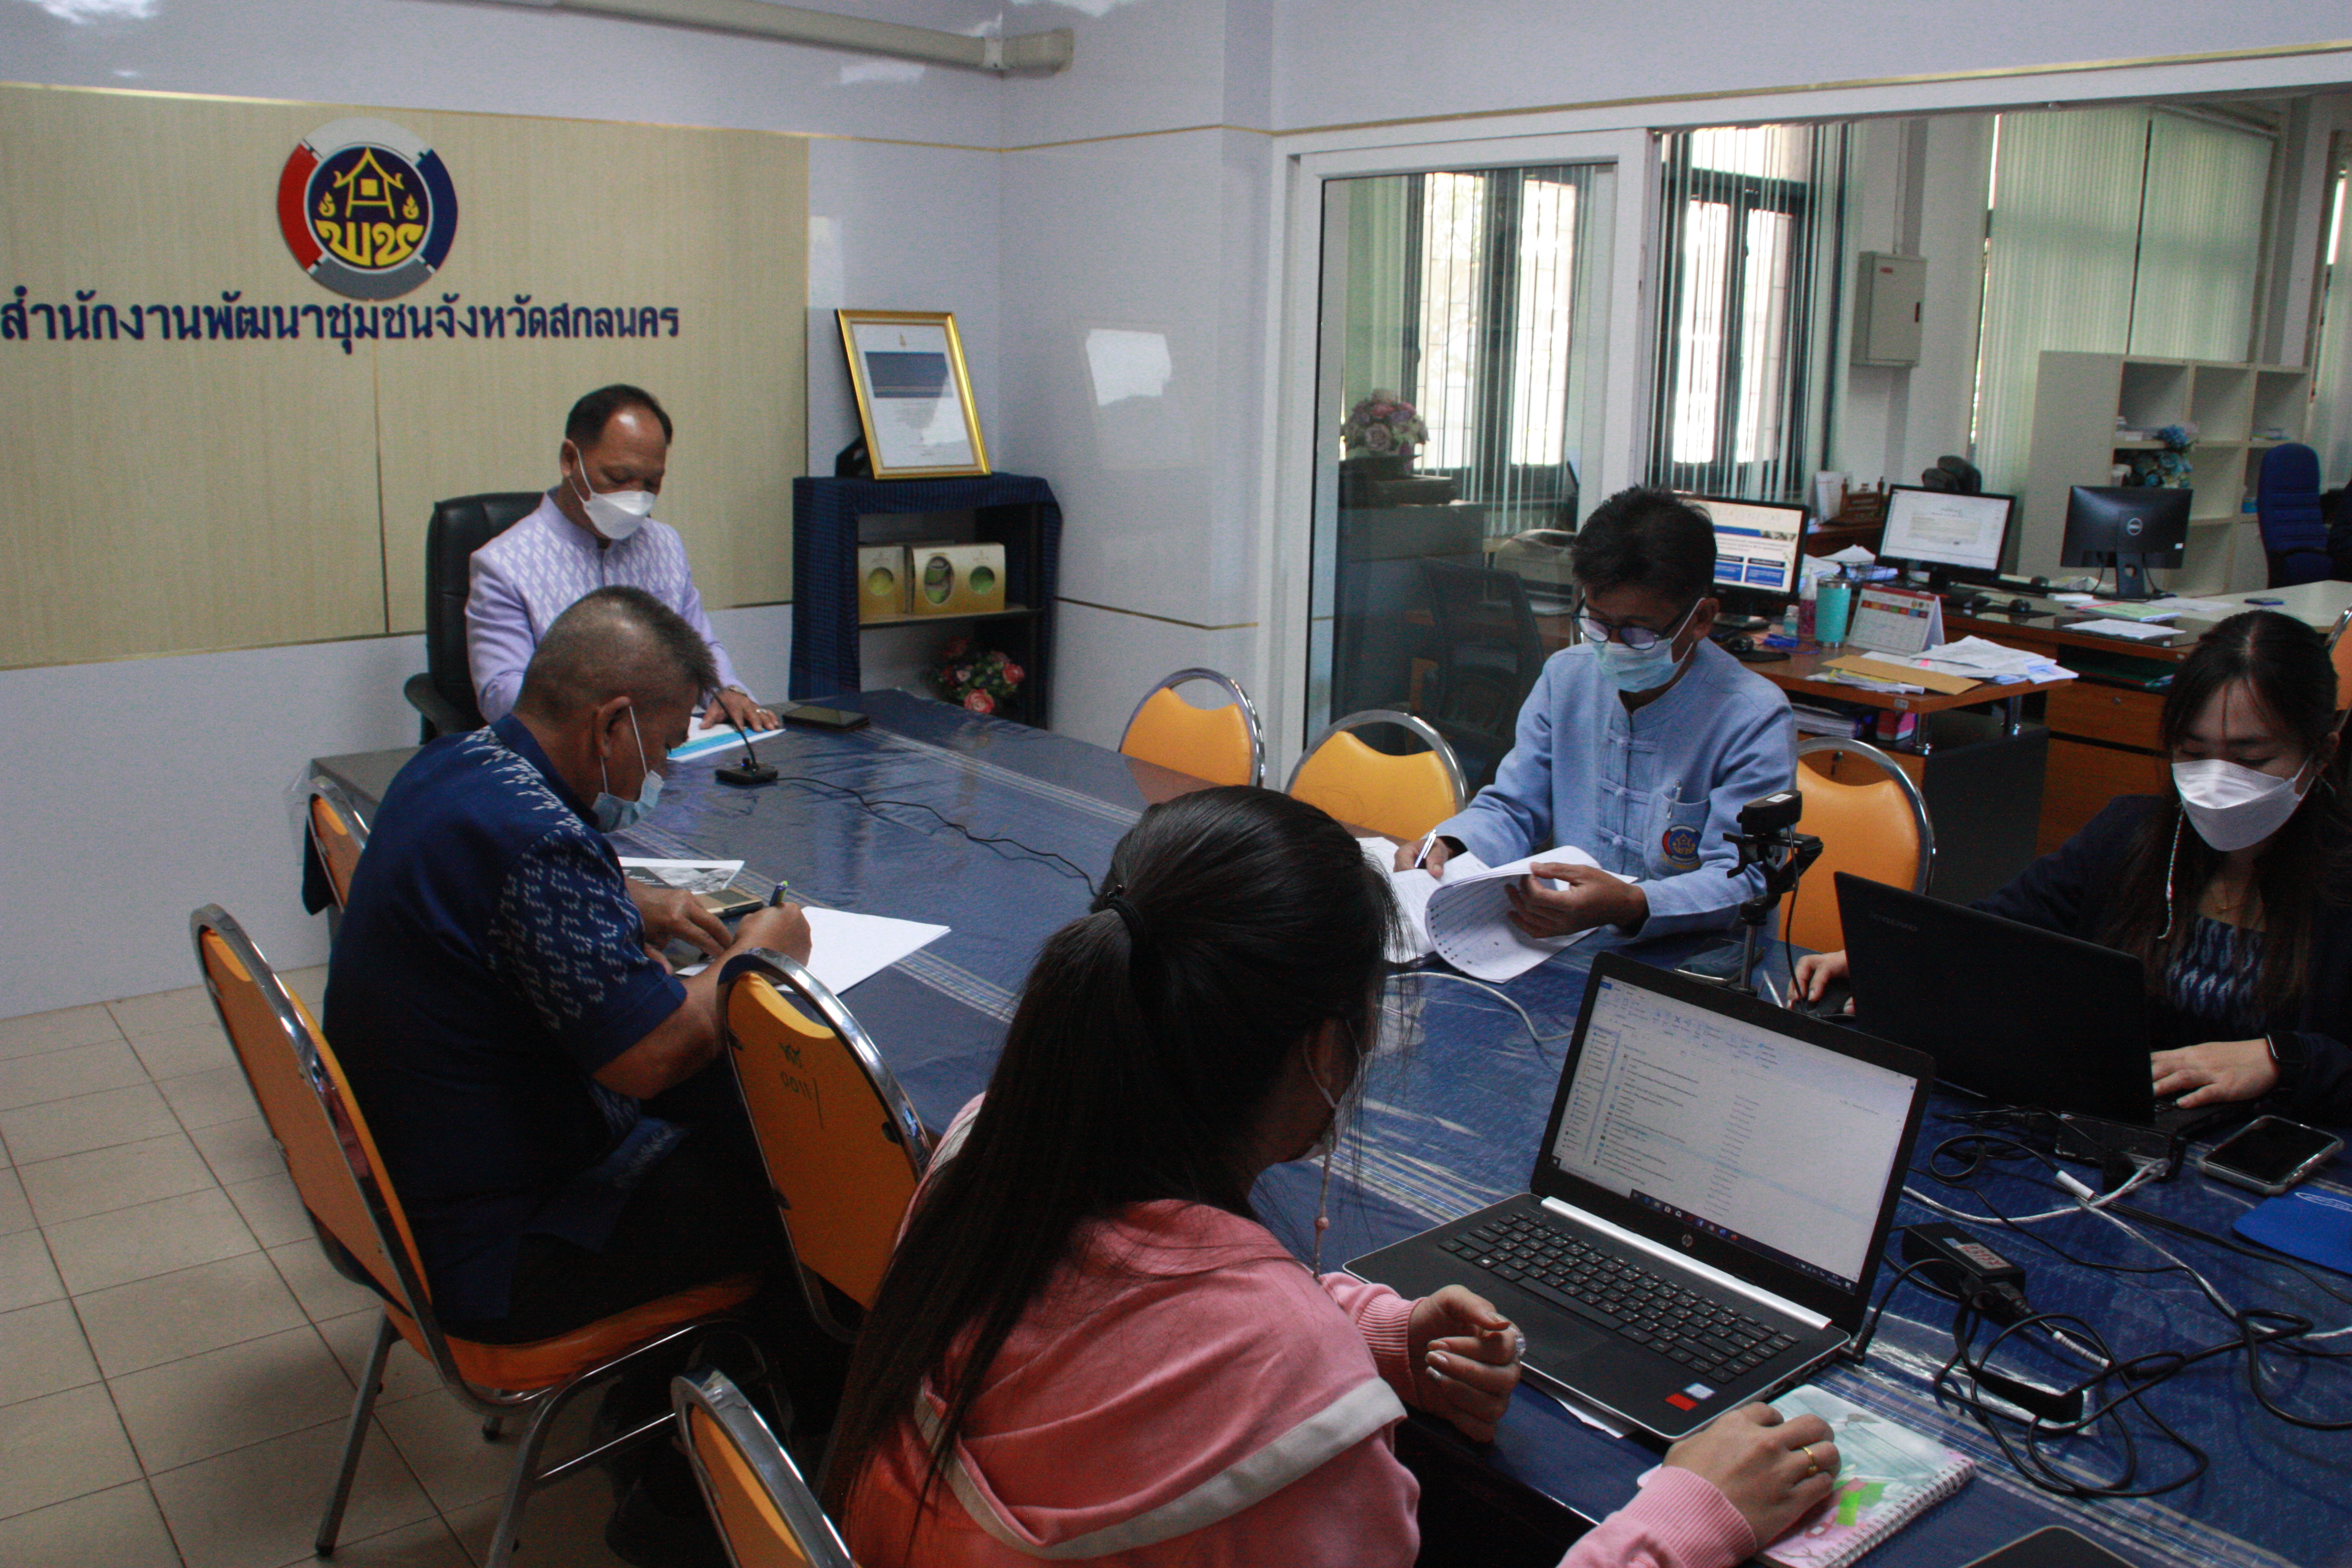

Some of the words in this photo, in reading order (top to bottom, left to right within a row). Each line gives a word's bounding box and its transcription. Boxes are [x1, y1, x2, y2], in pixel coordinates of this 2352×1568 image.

[1, 285, 679, 355] สำนักงานพัฒนาชุมชนจังหวัดสกลนคร
